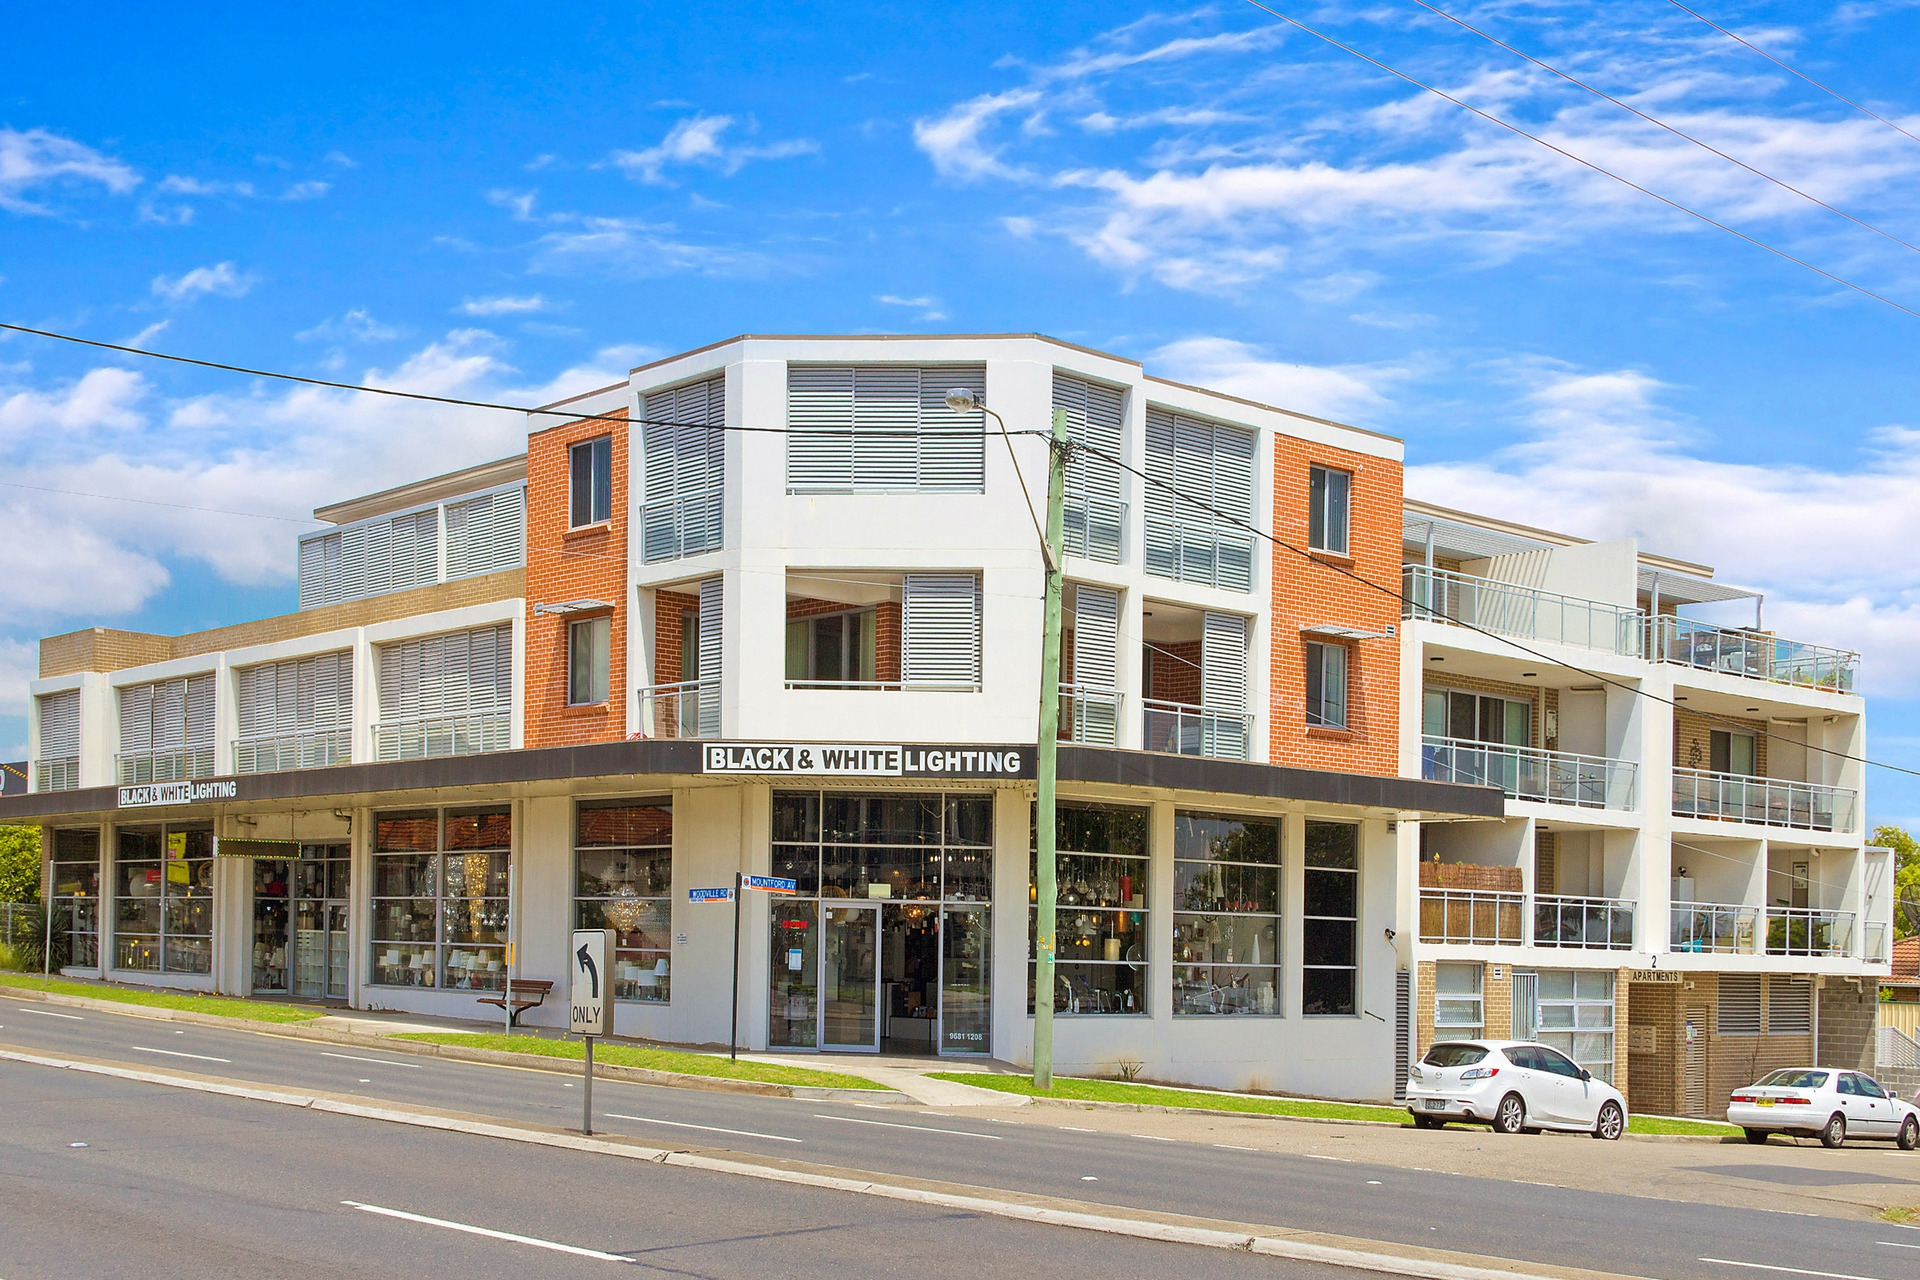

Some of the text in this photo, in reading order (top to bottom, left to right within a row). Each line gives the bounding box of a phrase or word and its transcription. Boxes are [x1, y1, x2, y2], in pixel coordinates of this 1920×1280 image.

[710, 748, 1021, 773] BLACK & WHITE LIGHTING
[120, 781, 237, 805] BLACK & WHITE LIGHTING
[751, 878, 786, 888] MOUNTFORD
[787, 881, 796, 890] AV
[692, 889, 727, 898] WOODVILLE RD
[781, 919, 808, 929] OPEN
[1651, 955, 1657, 969] 2
[1632, 971, 1678, 982] APARTMENTS
[572, 1005, 601, 1023] ONLY
[950, 1032, 983, 1041] 9681 1208
